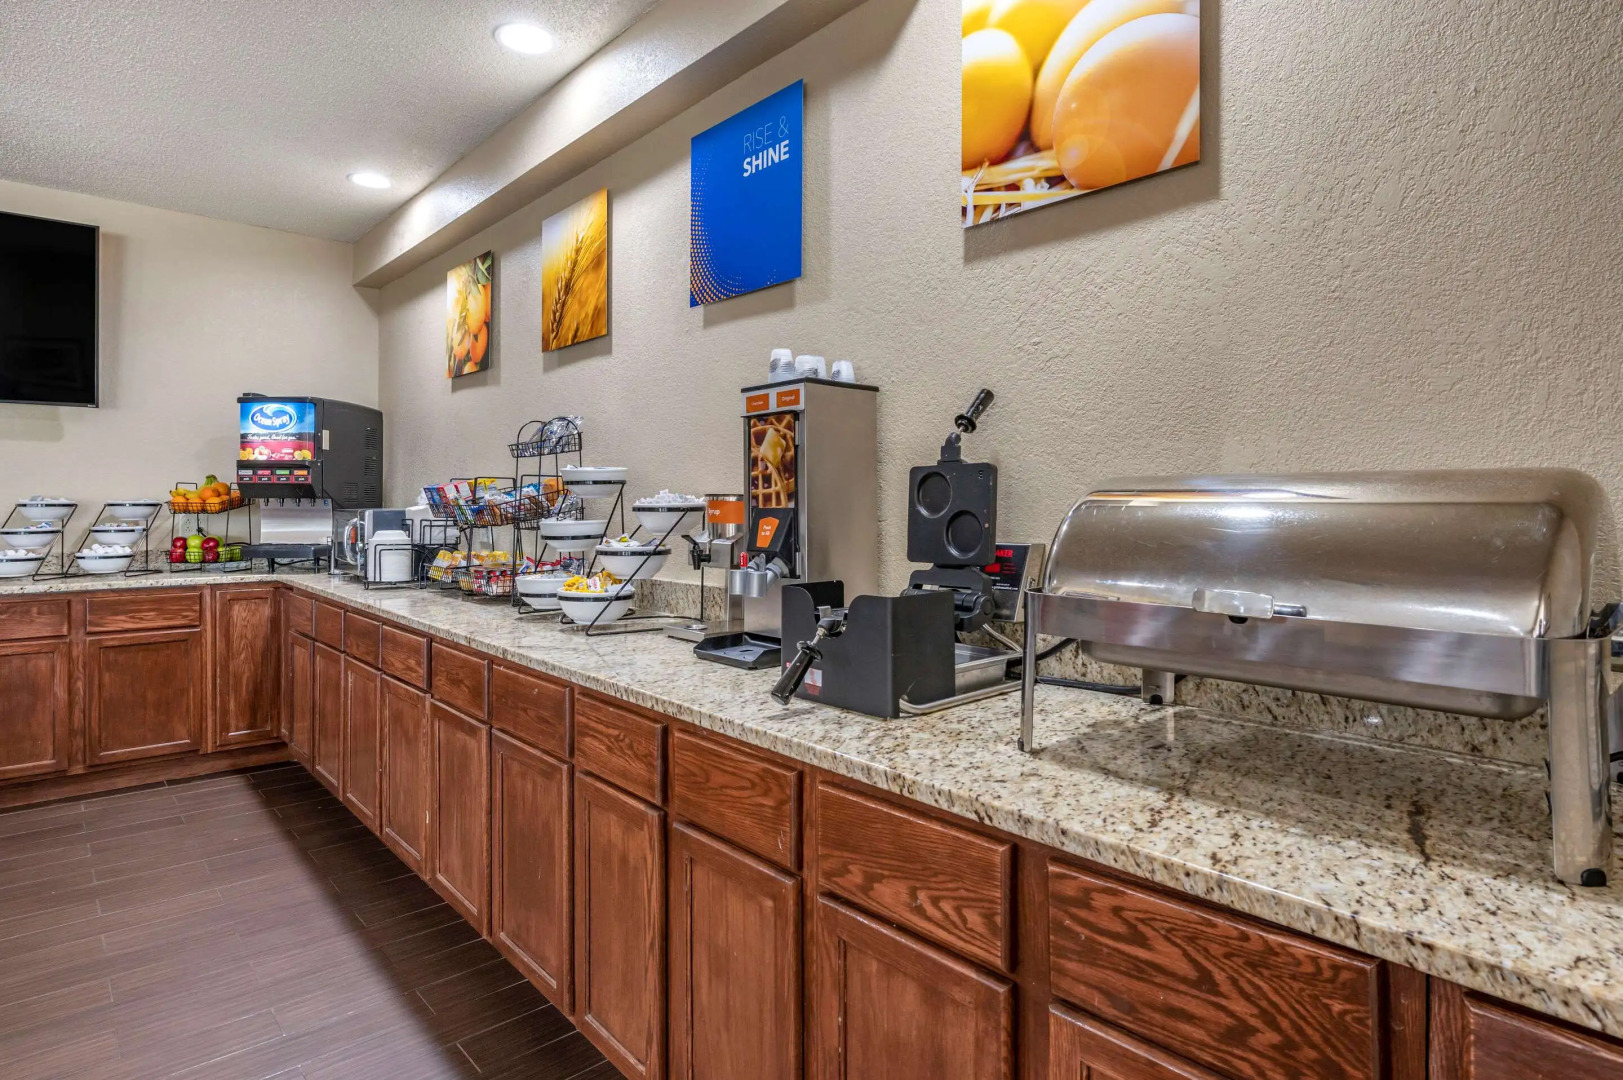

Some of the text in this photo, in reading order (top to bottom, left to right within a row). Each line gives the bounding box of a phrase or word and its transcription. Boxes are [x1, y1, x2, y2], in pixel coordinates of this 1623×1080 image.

[743, 116, 788, 154] RISE &
[742, 140, 790, 178] SHINE
[254, 413, 290, 428] Ocean Spray
[996, 550, 1013, 558] AKER
